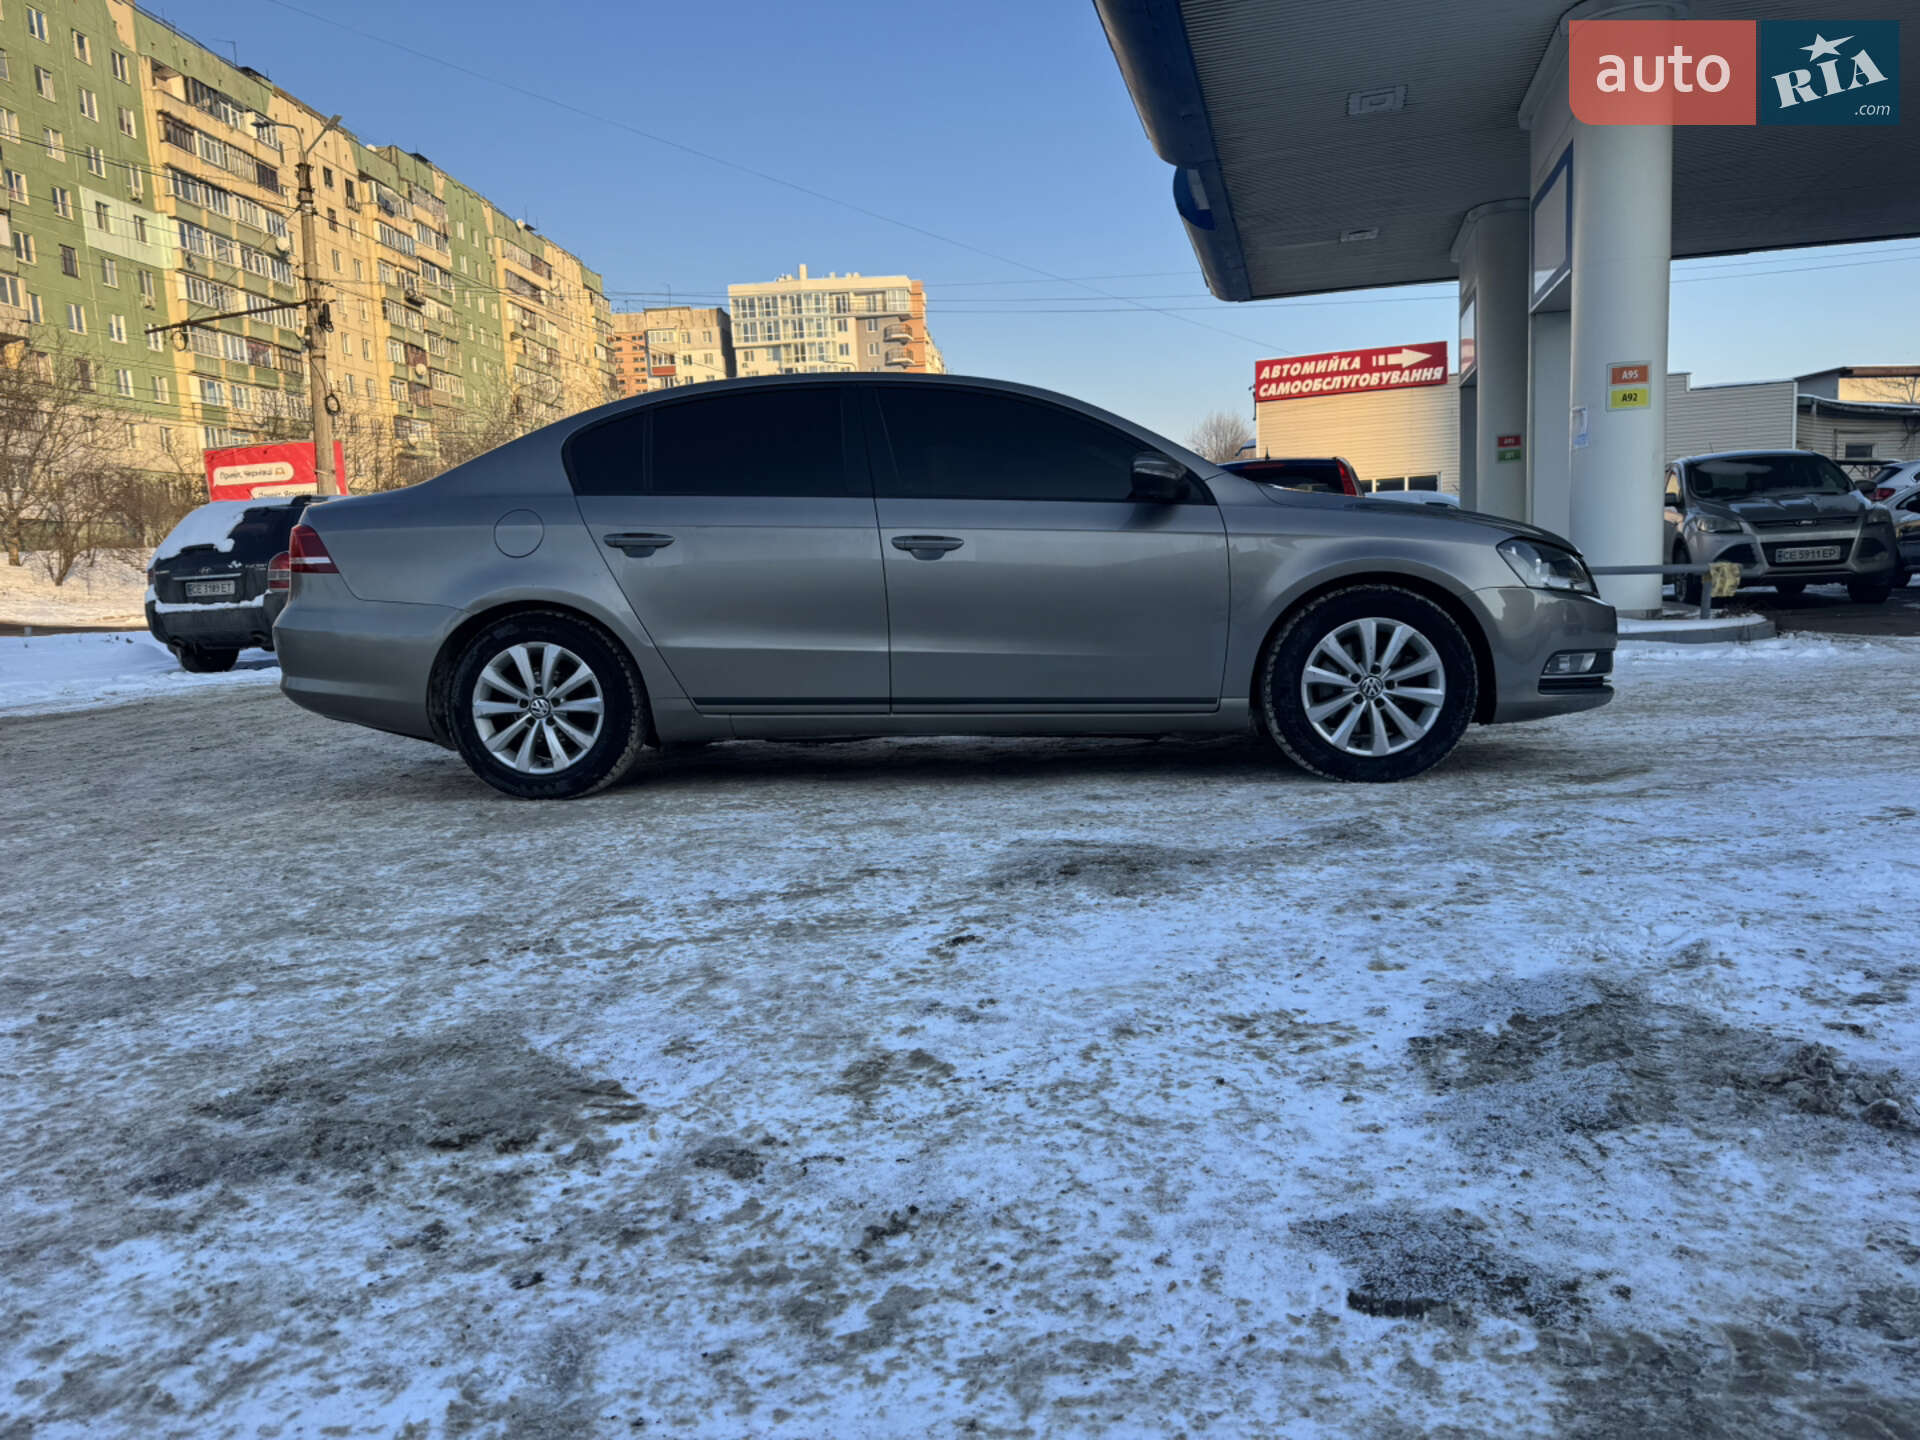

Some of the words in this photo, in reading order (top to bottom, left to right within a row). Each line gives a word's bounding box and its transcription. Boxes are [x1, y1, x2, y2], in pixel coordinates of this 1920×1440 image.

[1260, 355, 1361, 380] АВТОМИЙКА
[1622, 370, 1639, 380] A95
[1259, 367, 1444, 398] САМООБСЛУГОВУВАННЯ
[1622, 393, 1638, 402] A92
